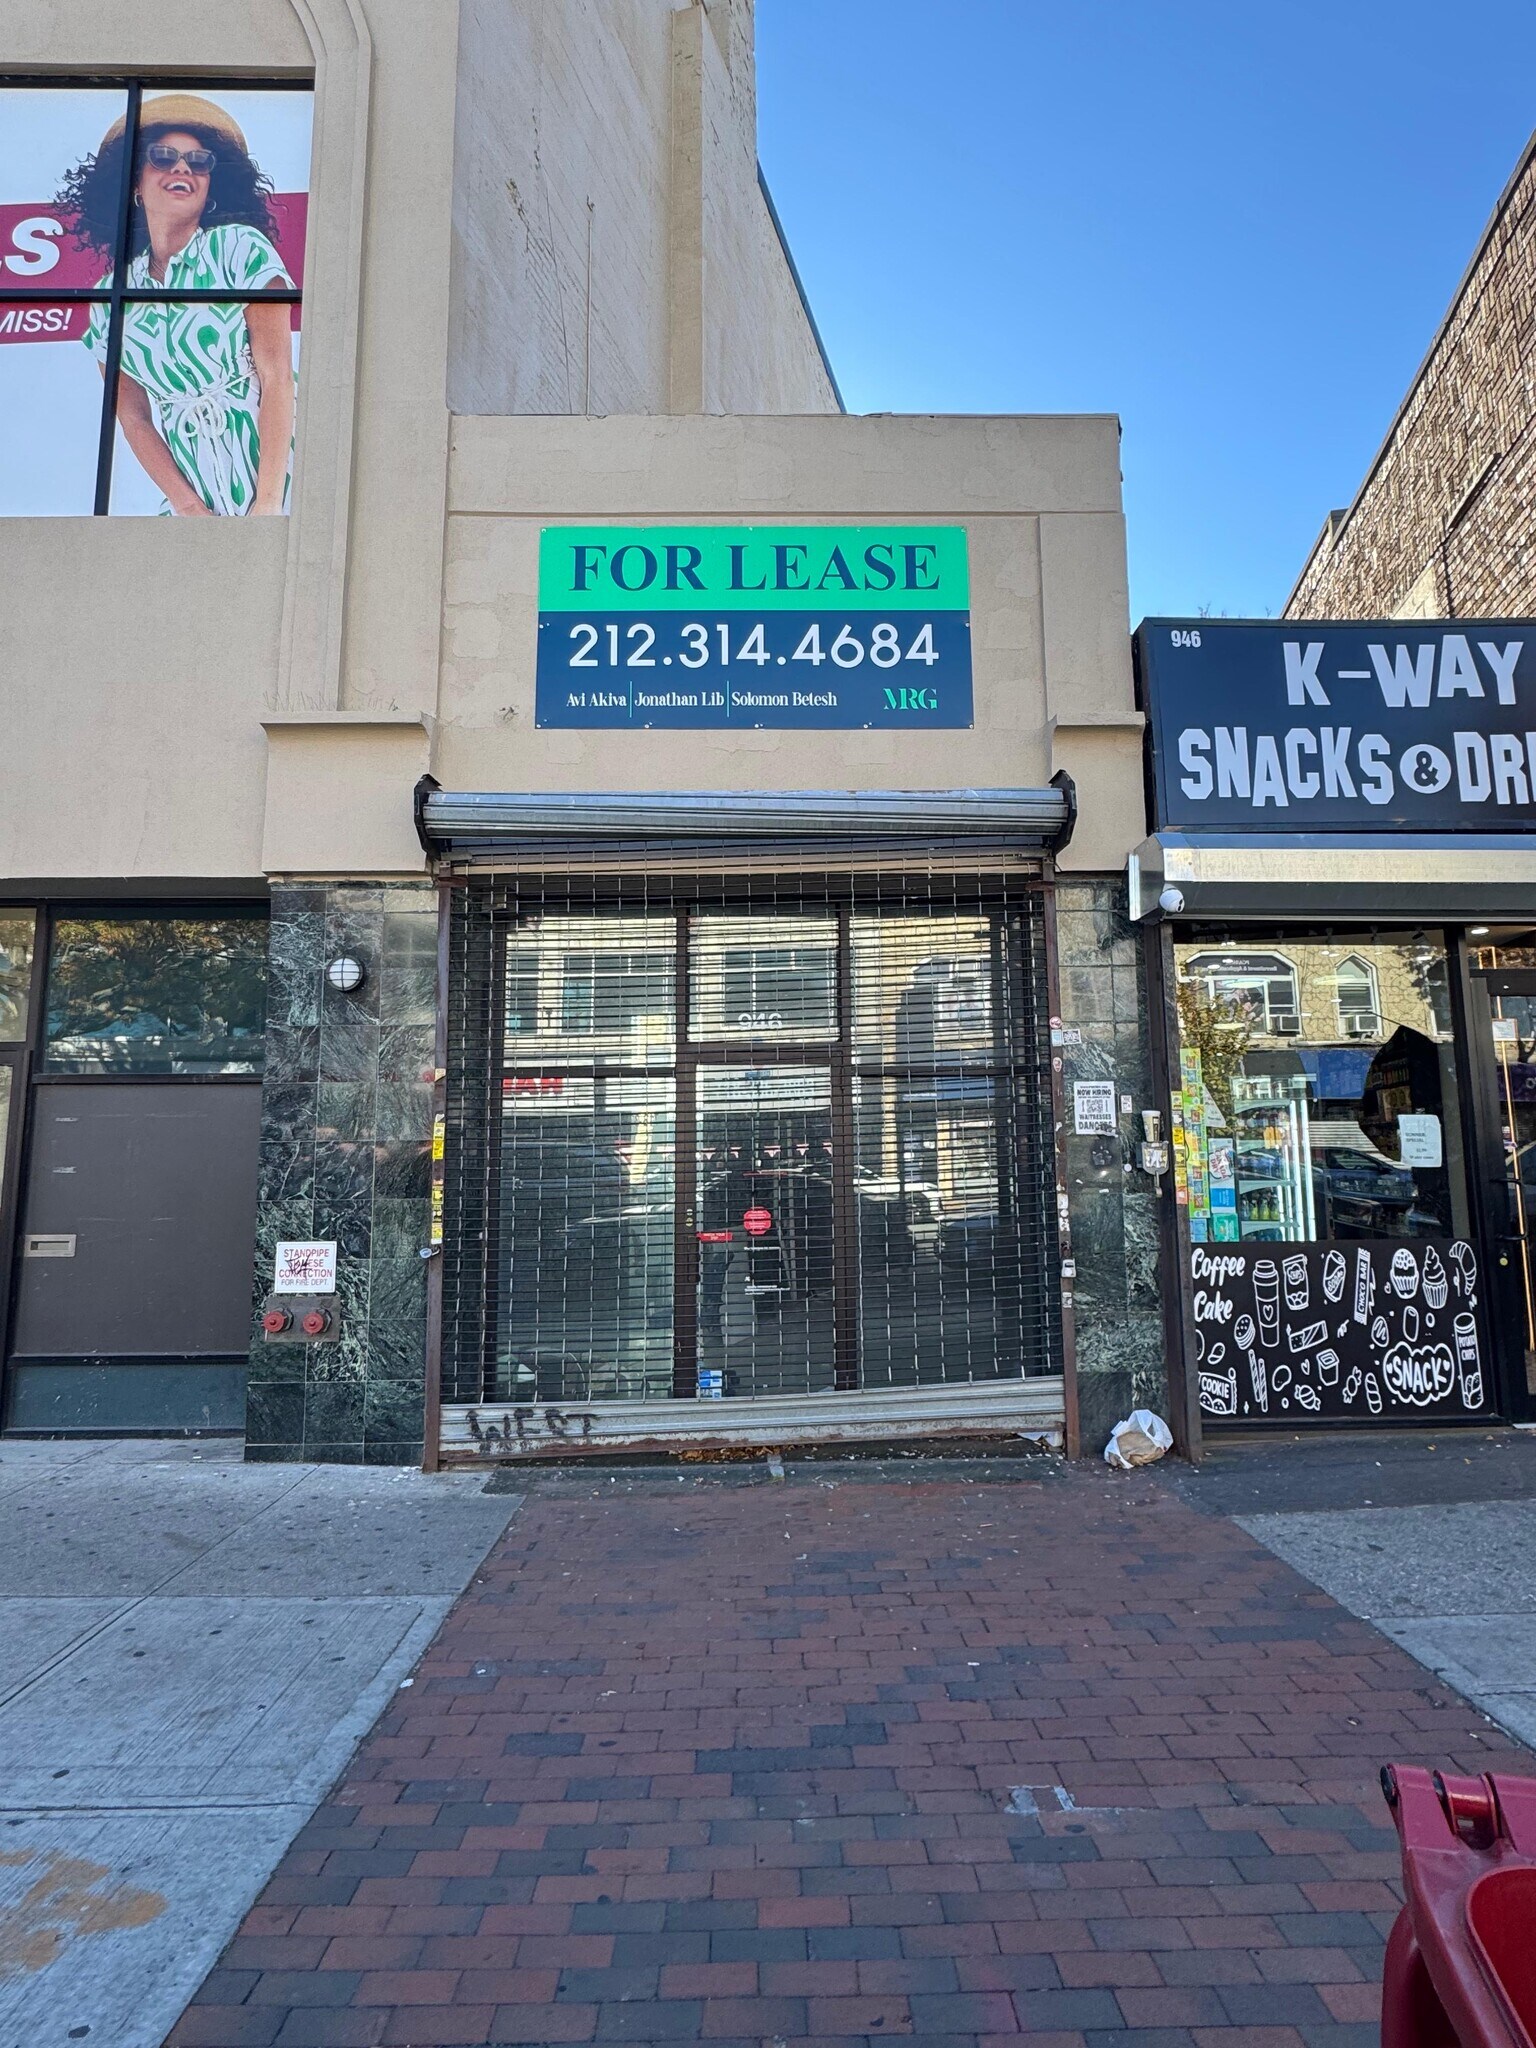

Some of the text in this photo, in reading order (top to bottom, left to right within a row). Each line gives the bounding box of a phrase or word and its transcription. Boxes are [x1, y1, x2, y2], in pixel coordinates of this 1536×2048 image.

[568, 544, 940, 591] FOR LEASE
[568, 623, 940, 669] 212.314.4684
[1171, 630, 1201, 648] 946
[566, 692, 627, 707] Avi Akiva
[634, 691, 725, 708] Jonathan Lib
[731, 691, 838, 707] Solomon Betesh
[1178, 727, 1395, 807] SNACKS
[738, 1013, 783, 1031] 946
[283, 1248, 329, 1257] STANDPIPE
[1191, 1248, 1246, 1286] Coffee
[1357, 1261, 1368, 1313] CHOCO BAR
[1193, 1290, 1234, 1324] Cake
[1201, 1376, 1230, 1399] COOKIE
[1391, 1355, 1448, 1394] SNACK
